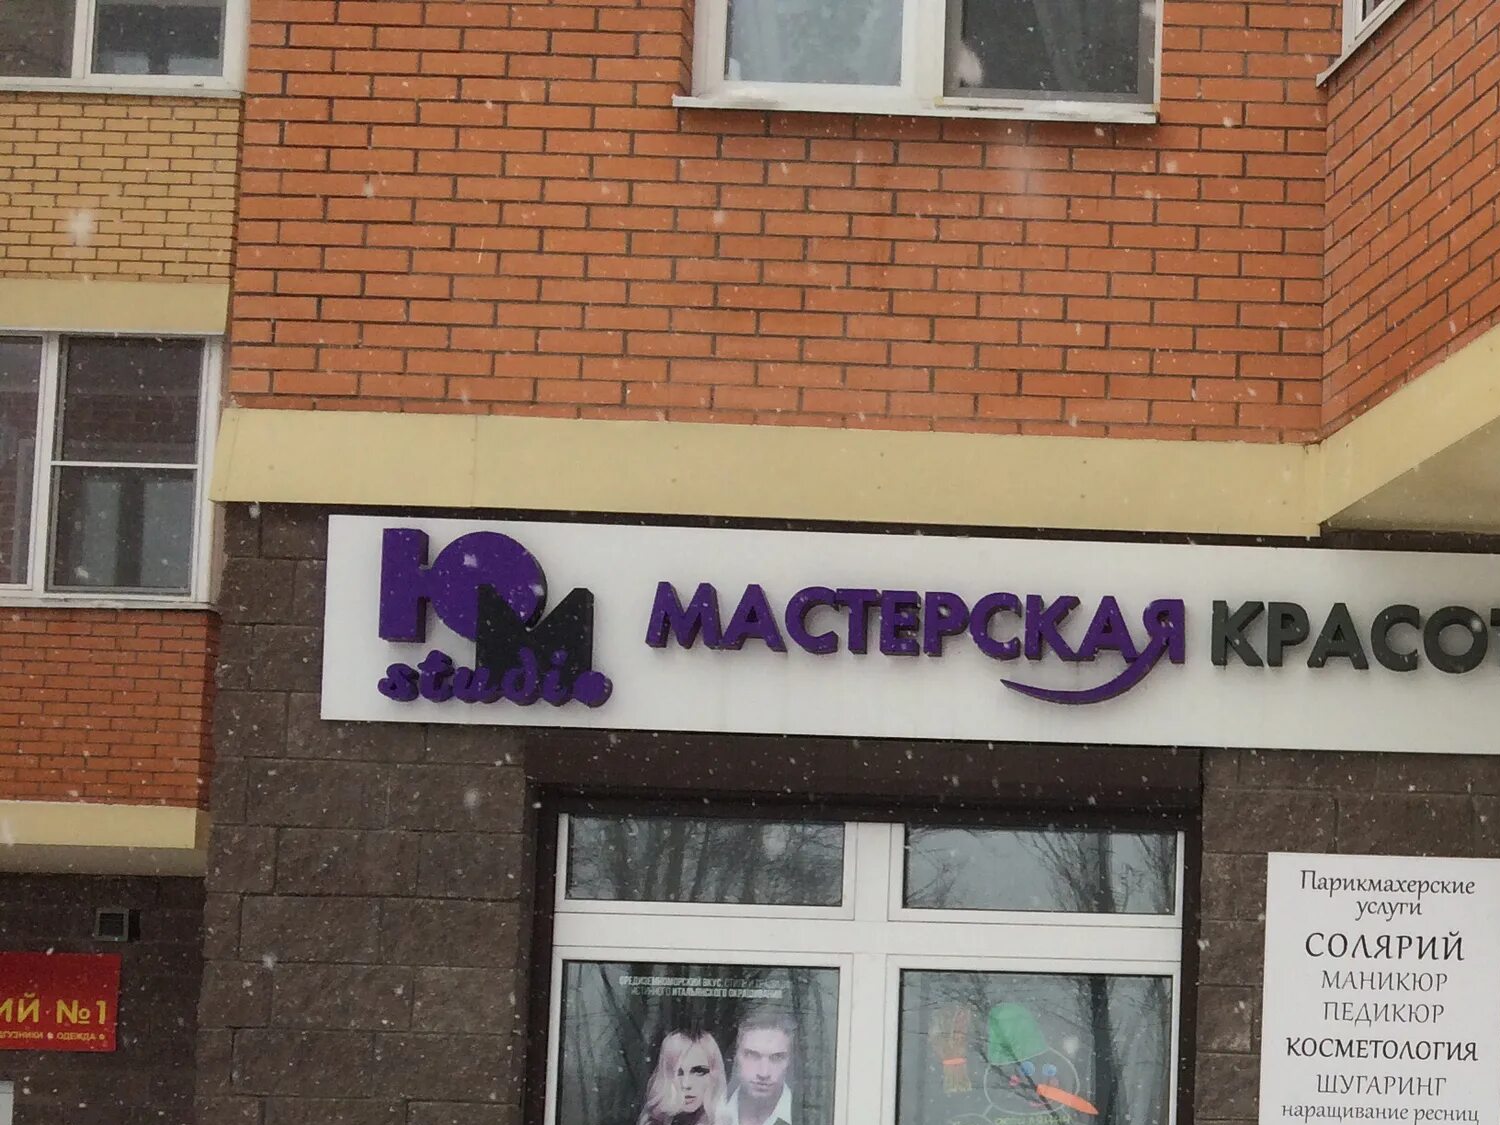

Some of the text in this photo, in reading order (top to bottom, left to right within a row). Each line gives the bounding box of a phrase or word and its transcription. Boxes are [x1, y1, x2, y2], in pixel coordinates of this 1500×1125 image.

[646, 582, 1186, 705] МАСТЕРСКАЯ
[378, 648, 613, 708] studio
[1300, 869, 1475, 895] Парикмахерские
[1355, 900, 1422, 921] услуги
[1305, 931, 1465, 961] СОЛЯРИЙ
[1321, 970, 1448, 992] МАНИКЮР
[1323, 1001, 1445, 1027] ПЕДИКЮР
[1286, 1037, 1478, 1061] КОСМЕТОЛОГИЯ
[1316, 1074, 1447, 1096] ШУГАРИНГ
[1281, 1104, 1479, 1125] наращивание ресниц
